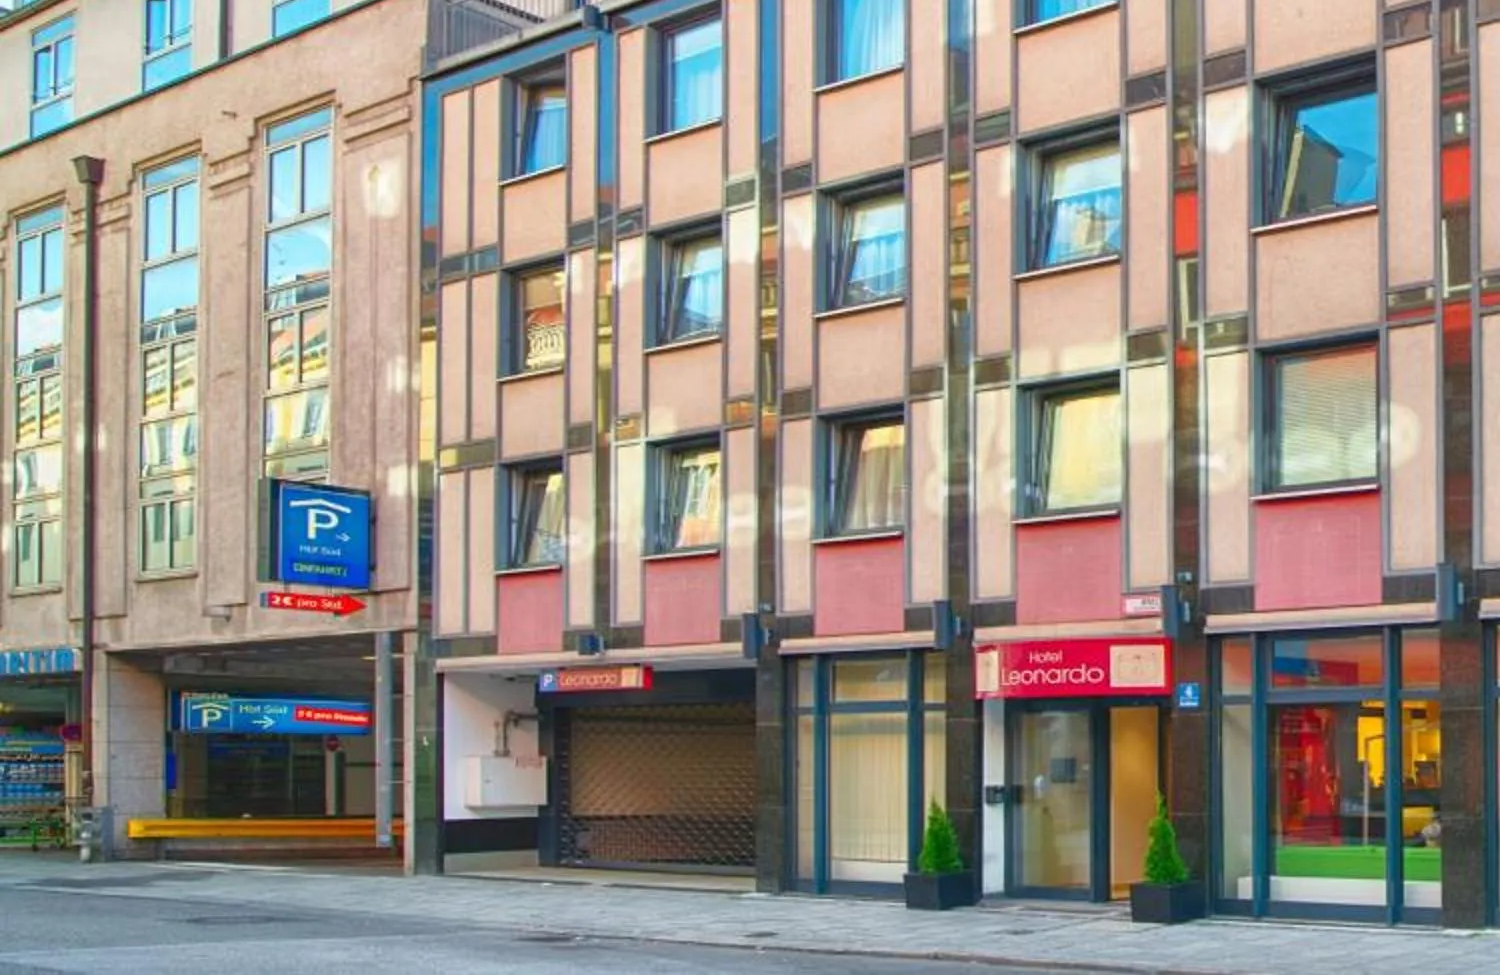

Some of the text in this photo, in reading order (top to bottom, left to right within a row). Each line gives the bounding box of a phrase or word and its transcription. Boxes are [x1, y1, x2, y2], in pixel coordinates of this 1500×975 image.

[307, 508, 339, 539] P
[1029, 650, 1062, 664] Hotel
[1001, 664, 1105, 686] Leonardo
[202, 708, 222, 728] P
